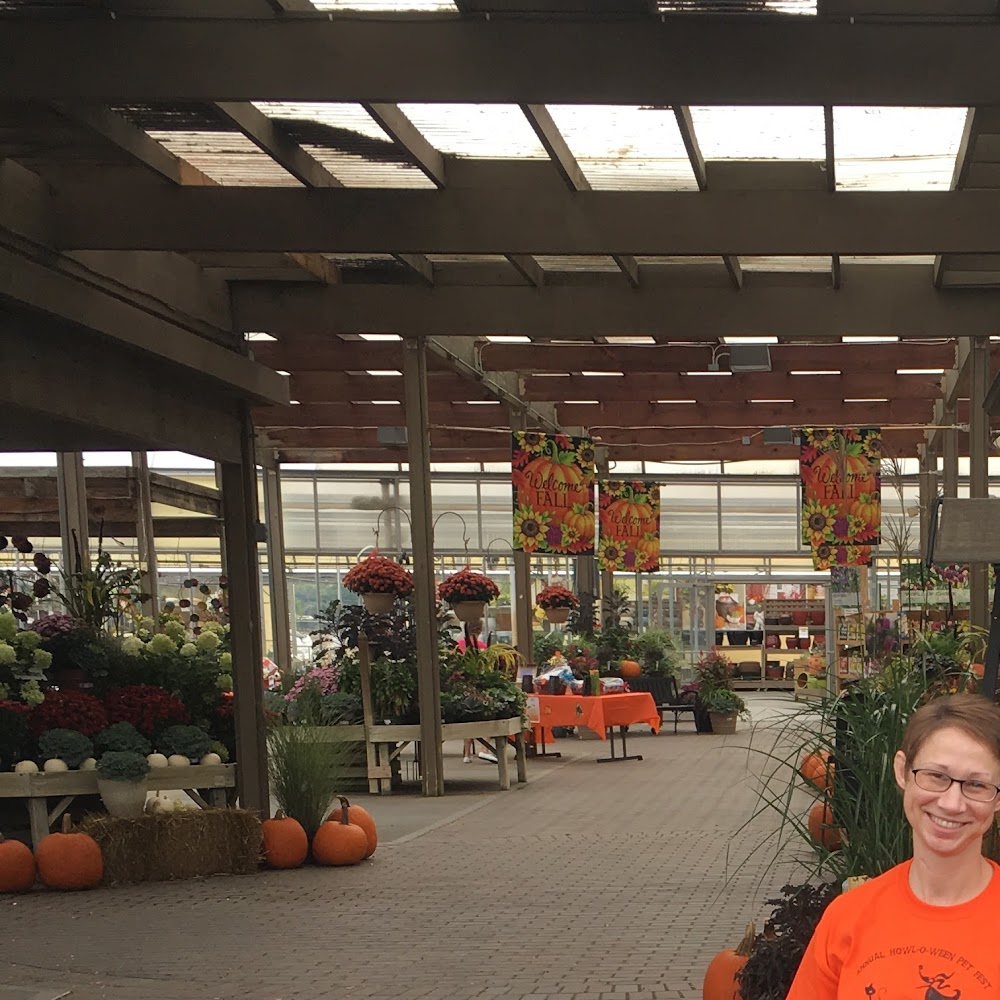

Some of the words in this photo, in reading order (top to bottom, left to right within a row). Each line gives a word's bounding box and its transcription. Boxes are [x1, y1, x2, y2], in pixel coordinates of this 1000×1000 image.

[525, 470, 582, 492] Welcome
[536, 490, 569, 507] FALL
[607, 509, 652, 525] Welcome
[616, 525, 641, 537] FALL
[856, 951, 886, 975] ANNUAL
[889, 945, 957, 962] HOWL-O-WEEN
[956, 956, 975, 972] PET
[973, 970, 993, 990] FEST
